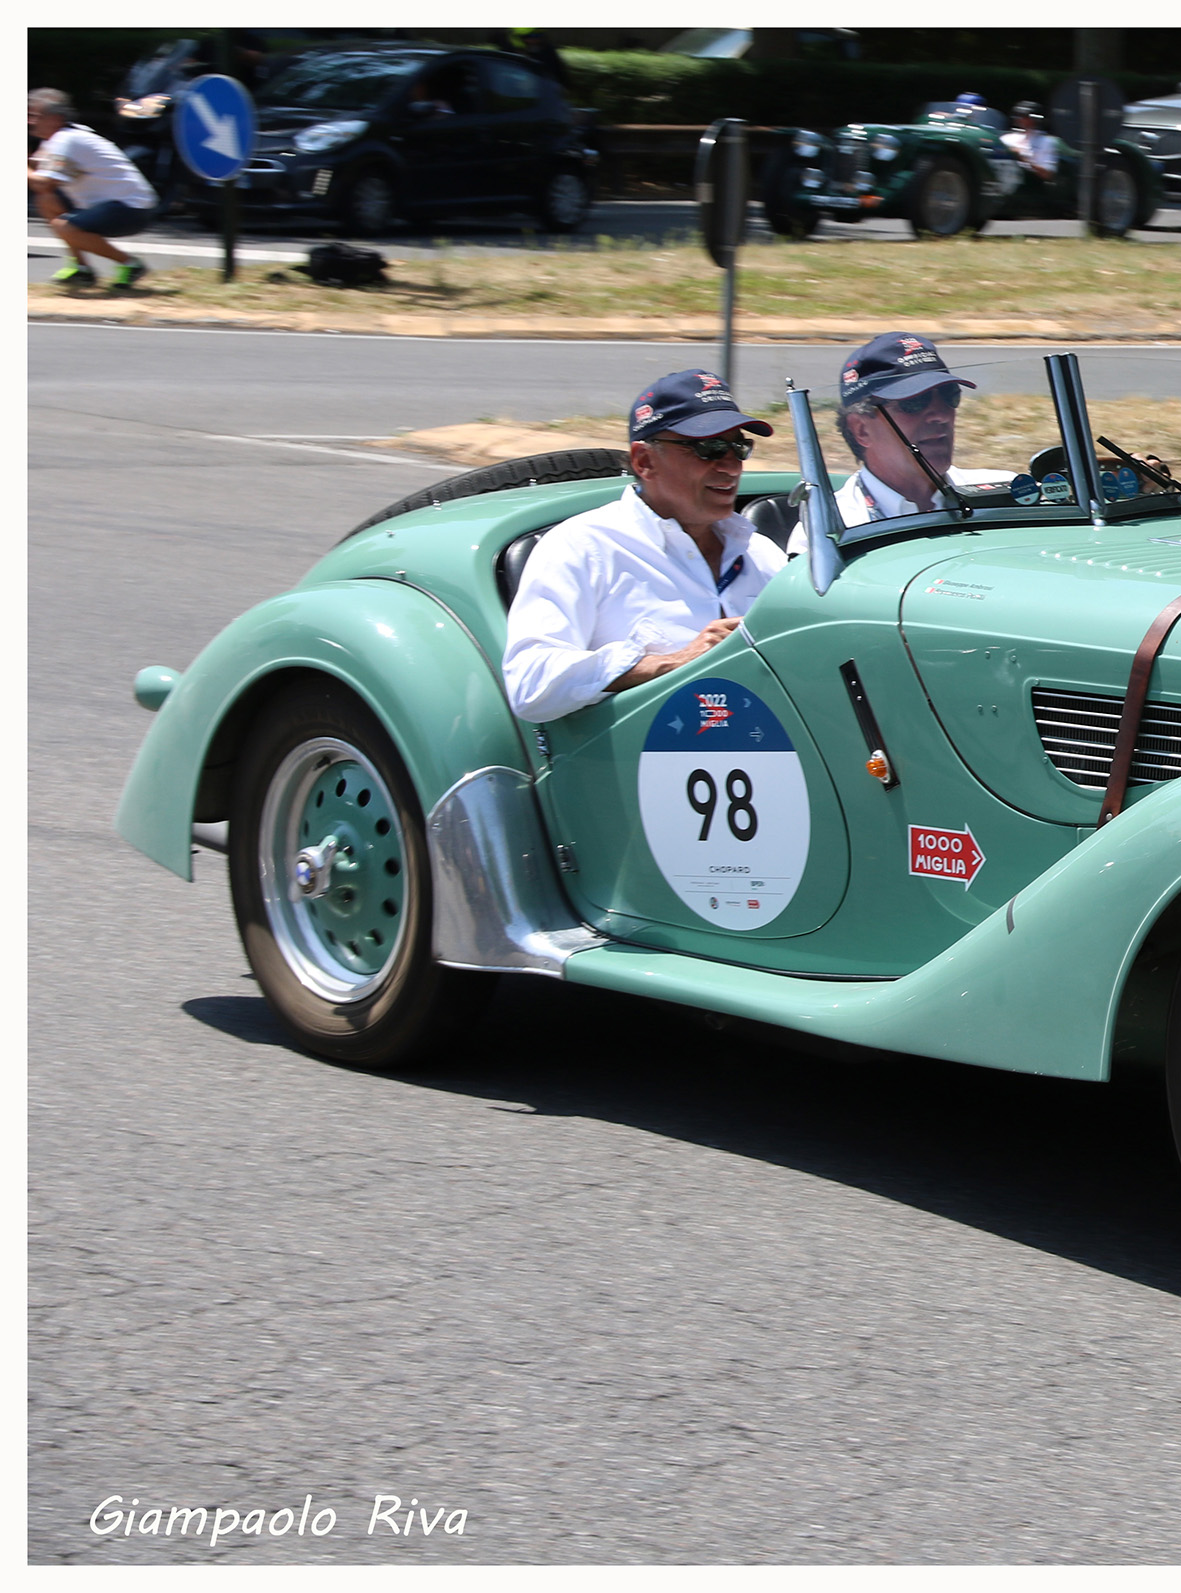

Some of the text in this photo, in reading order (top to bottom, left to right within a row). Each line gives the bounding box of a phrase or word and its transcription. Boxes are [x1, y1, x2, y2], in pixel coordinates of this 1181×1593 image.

[698, 693, 728, 708] 2022
[699, 709, 729, 718] 1000
[700, 720, 729, 728] MIGLIA
[687, 768, 758, 842] 98
[917, 833, 963, 853] 1000
[708, 865, 751, 874] CHOPARD
[915, 854, 967, 875] MIGLIA
